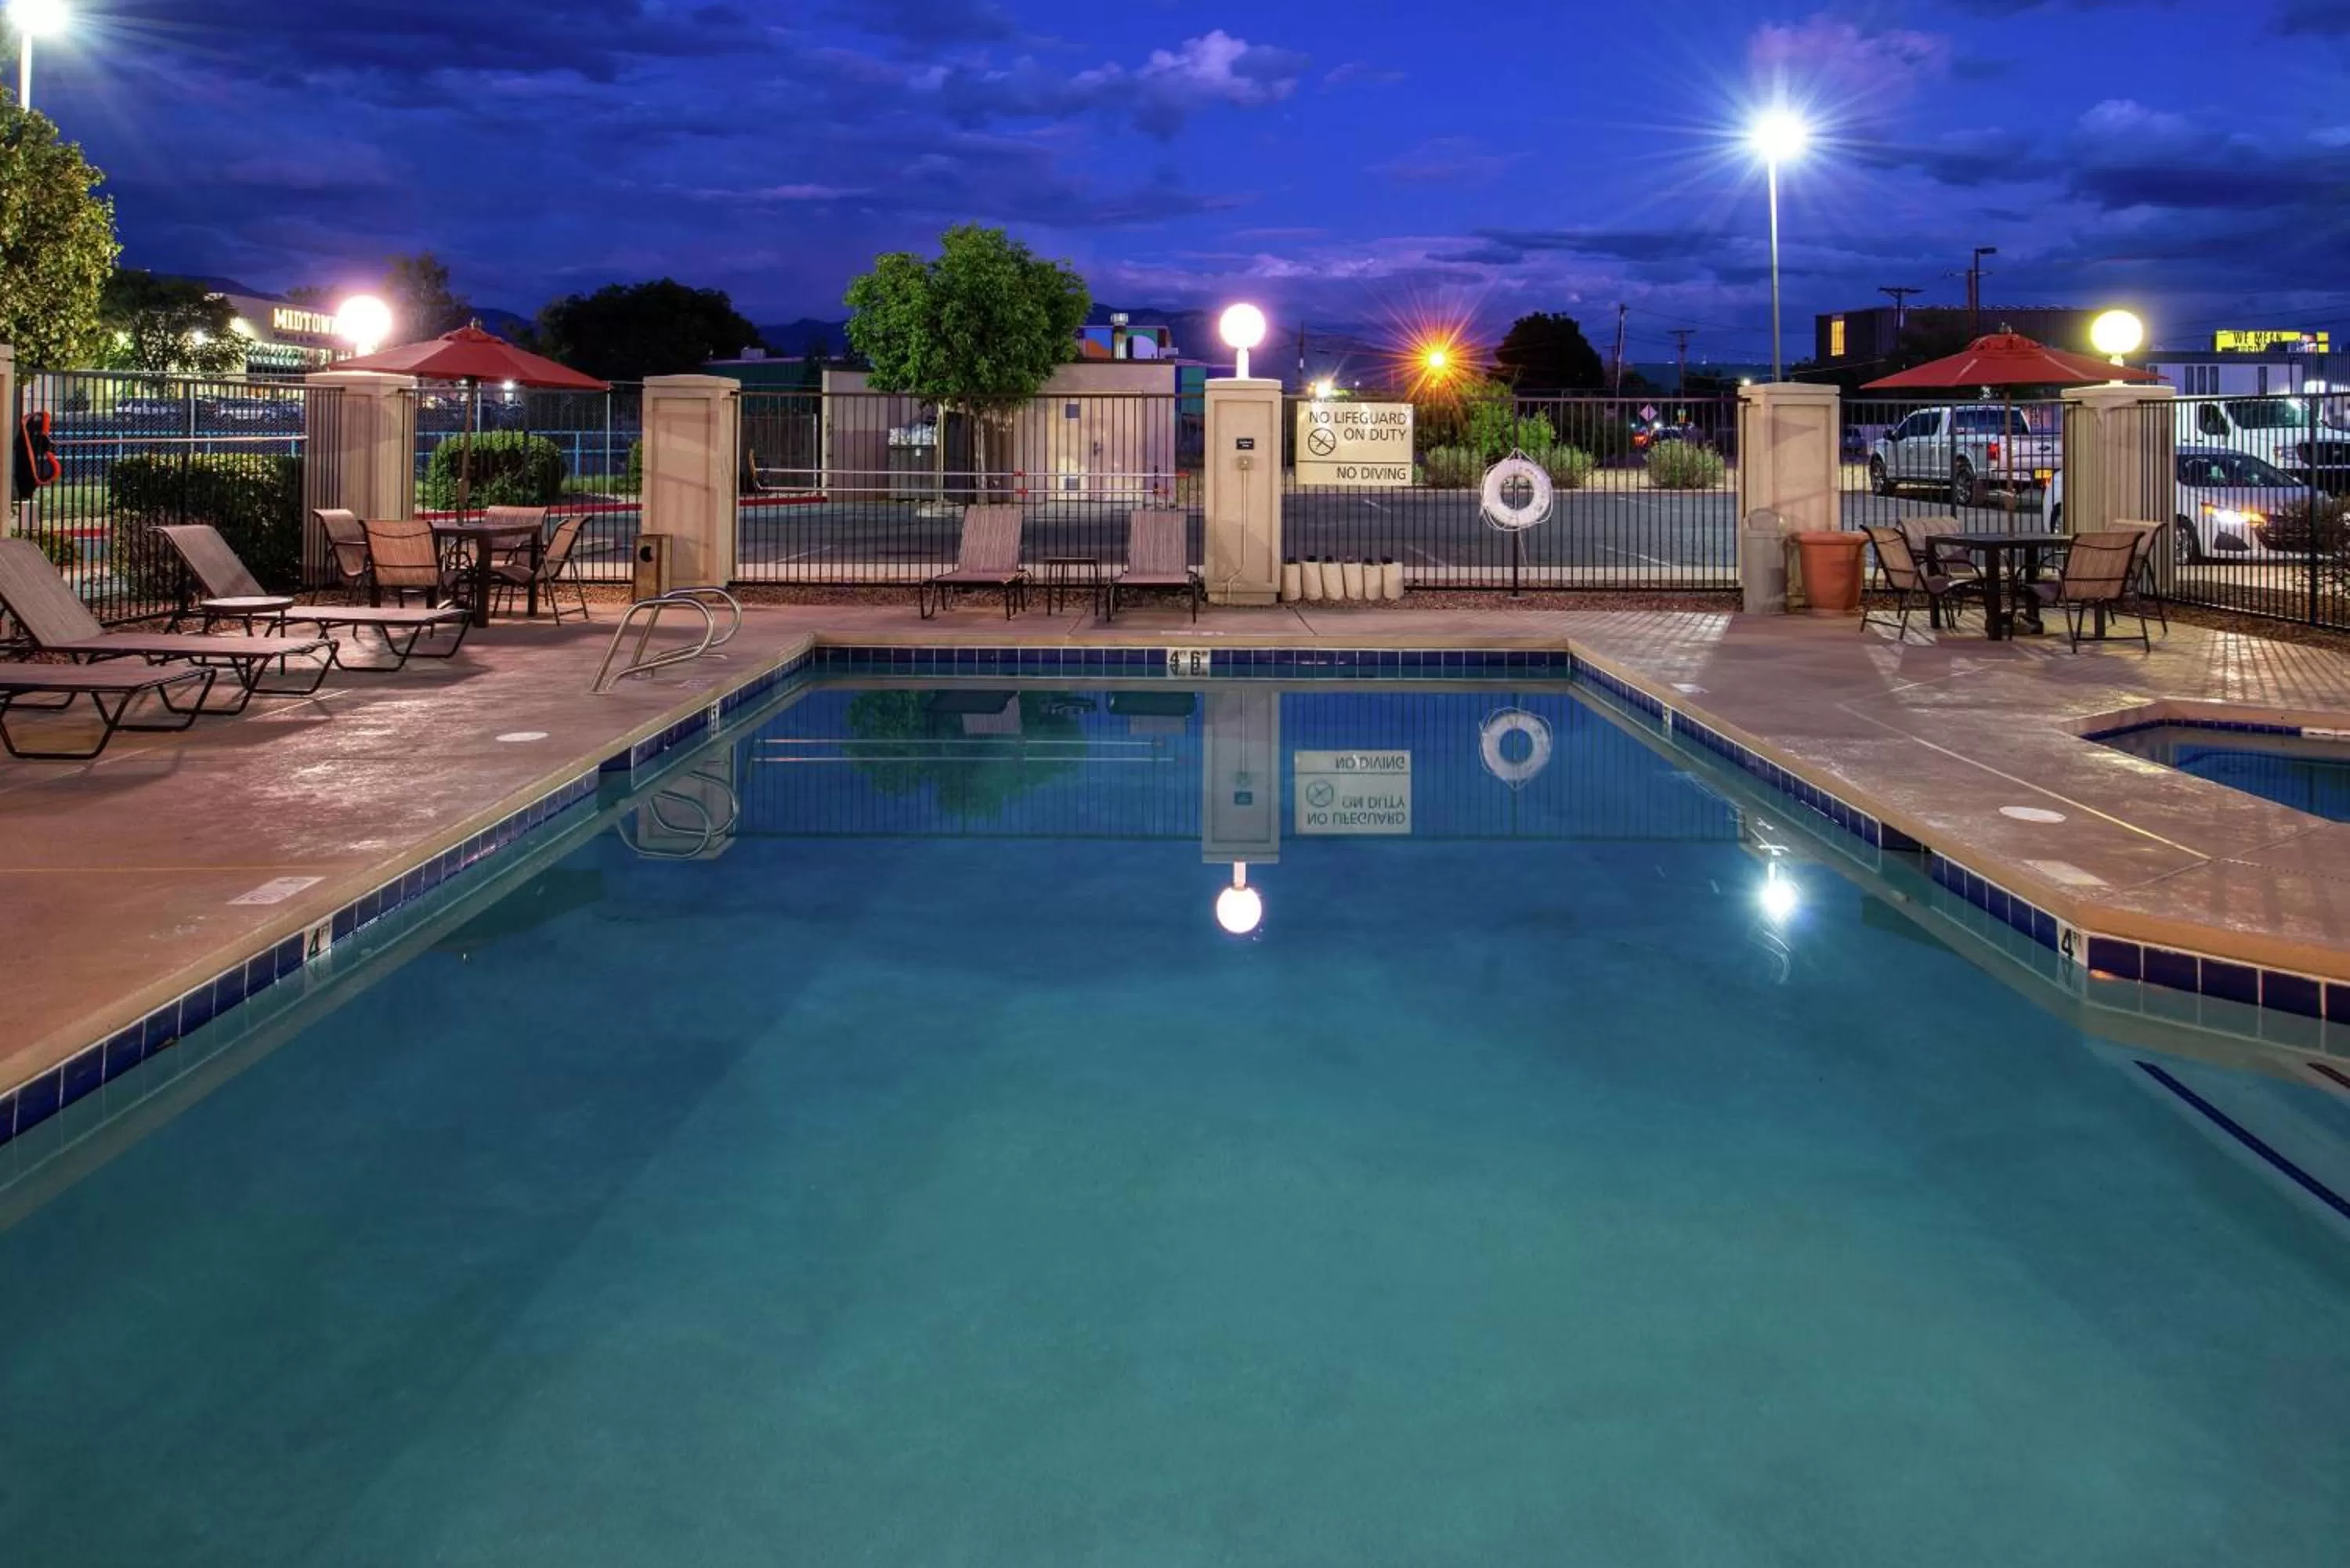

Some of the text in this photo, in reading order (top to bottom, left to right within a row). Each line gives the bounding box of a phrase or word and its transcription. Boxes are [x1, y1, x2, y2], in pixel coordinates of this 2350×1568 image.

[1309, 411, 1407, 425] NO LIFEGUARD
[1343, 428, 1407, 441] ON DUTY
[1336, 466, 1407, 480] NO DIVING
[2061, 928, 2074, 957] 4
